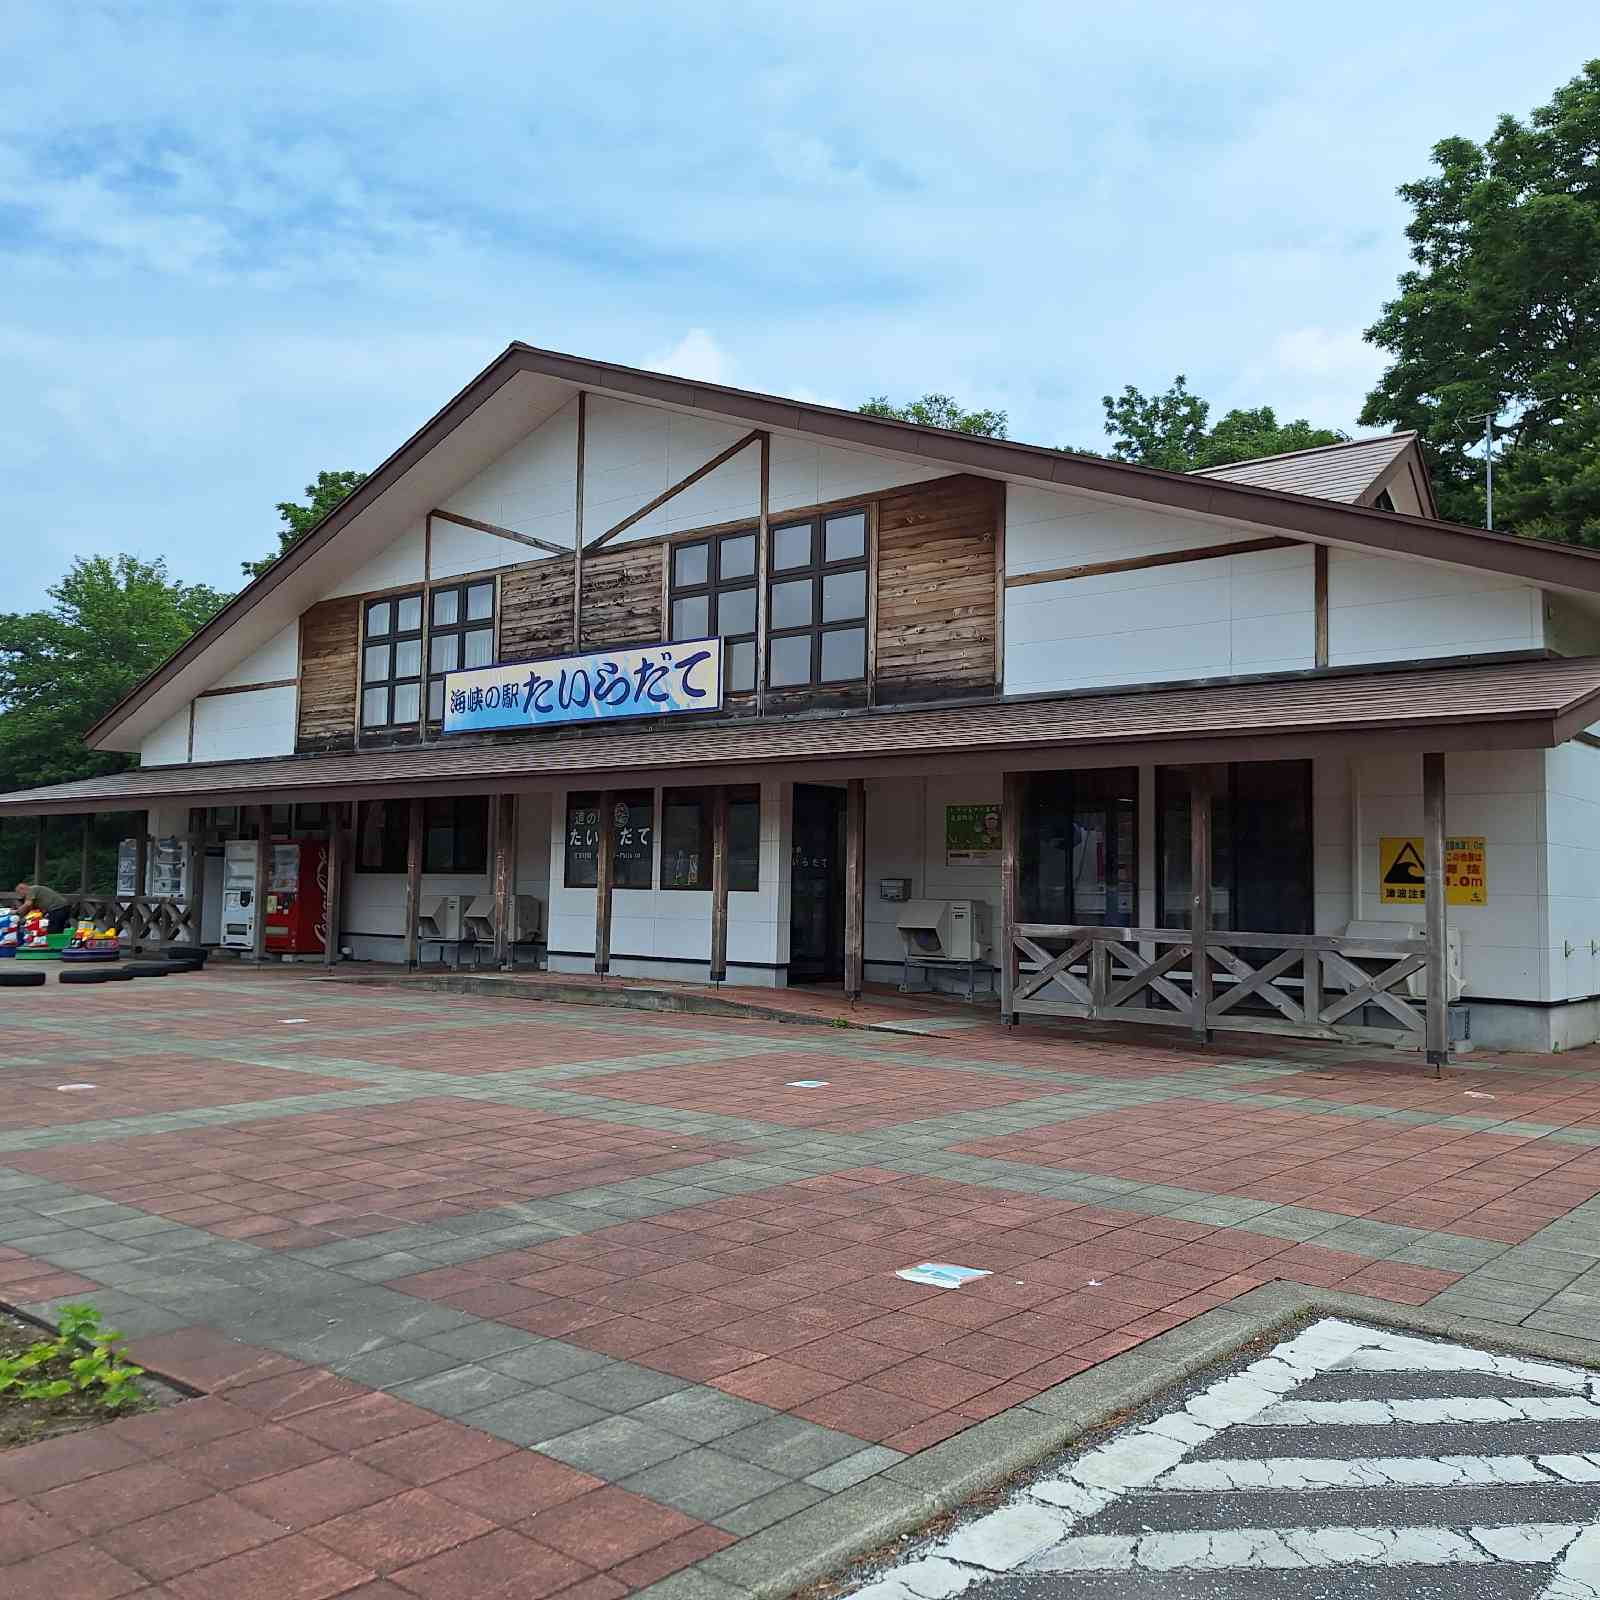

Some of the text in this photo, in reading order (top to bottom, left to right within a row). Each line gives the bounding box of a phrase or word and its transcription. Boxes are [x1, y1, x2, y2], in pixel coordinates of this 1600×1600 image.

[450, 650, 712, 714] 海峡の駅 たいらだて
[570, 827, 651, 846] たいだて
